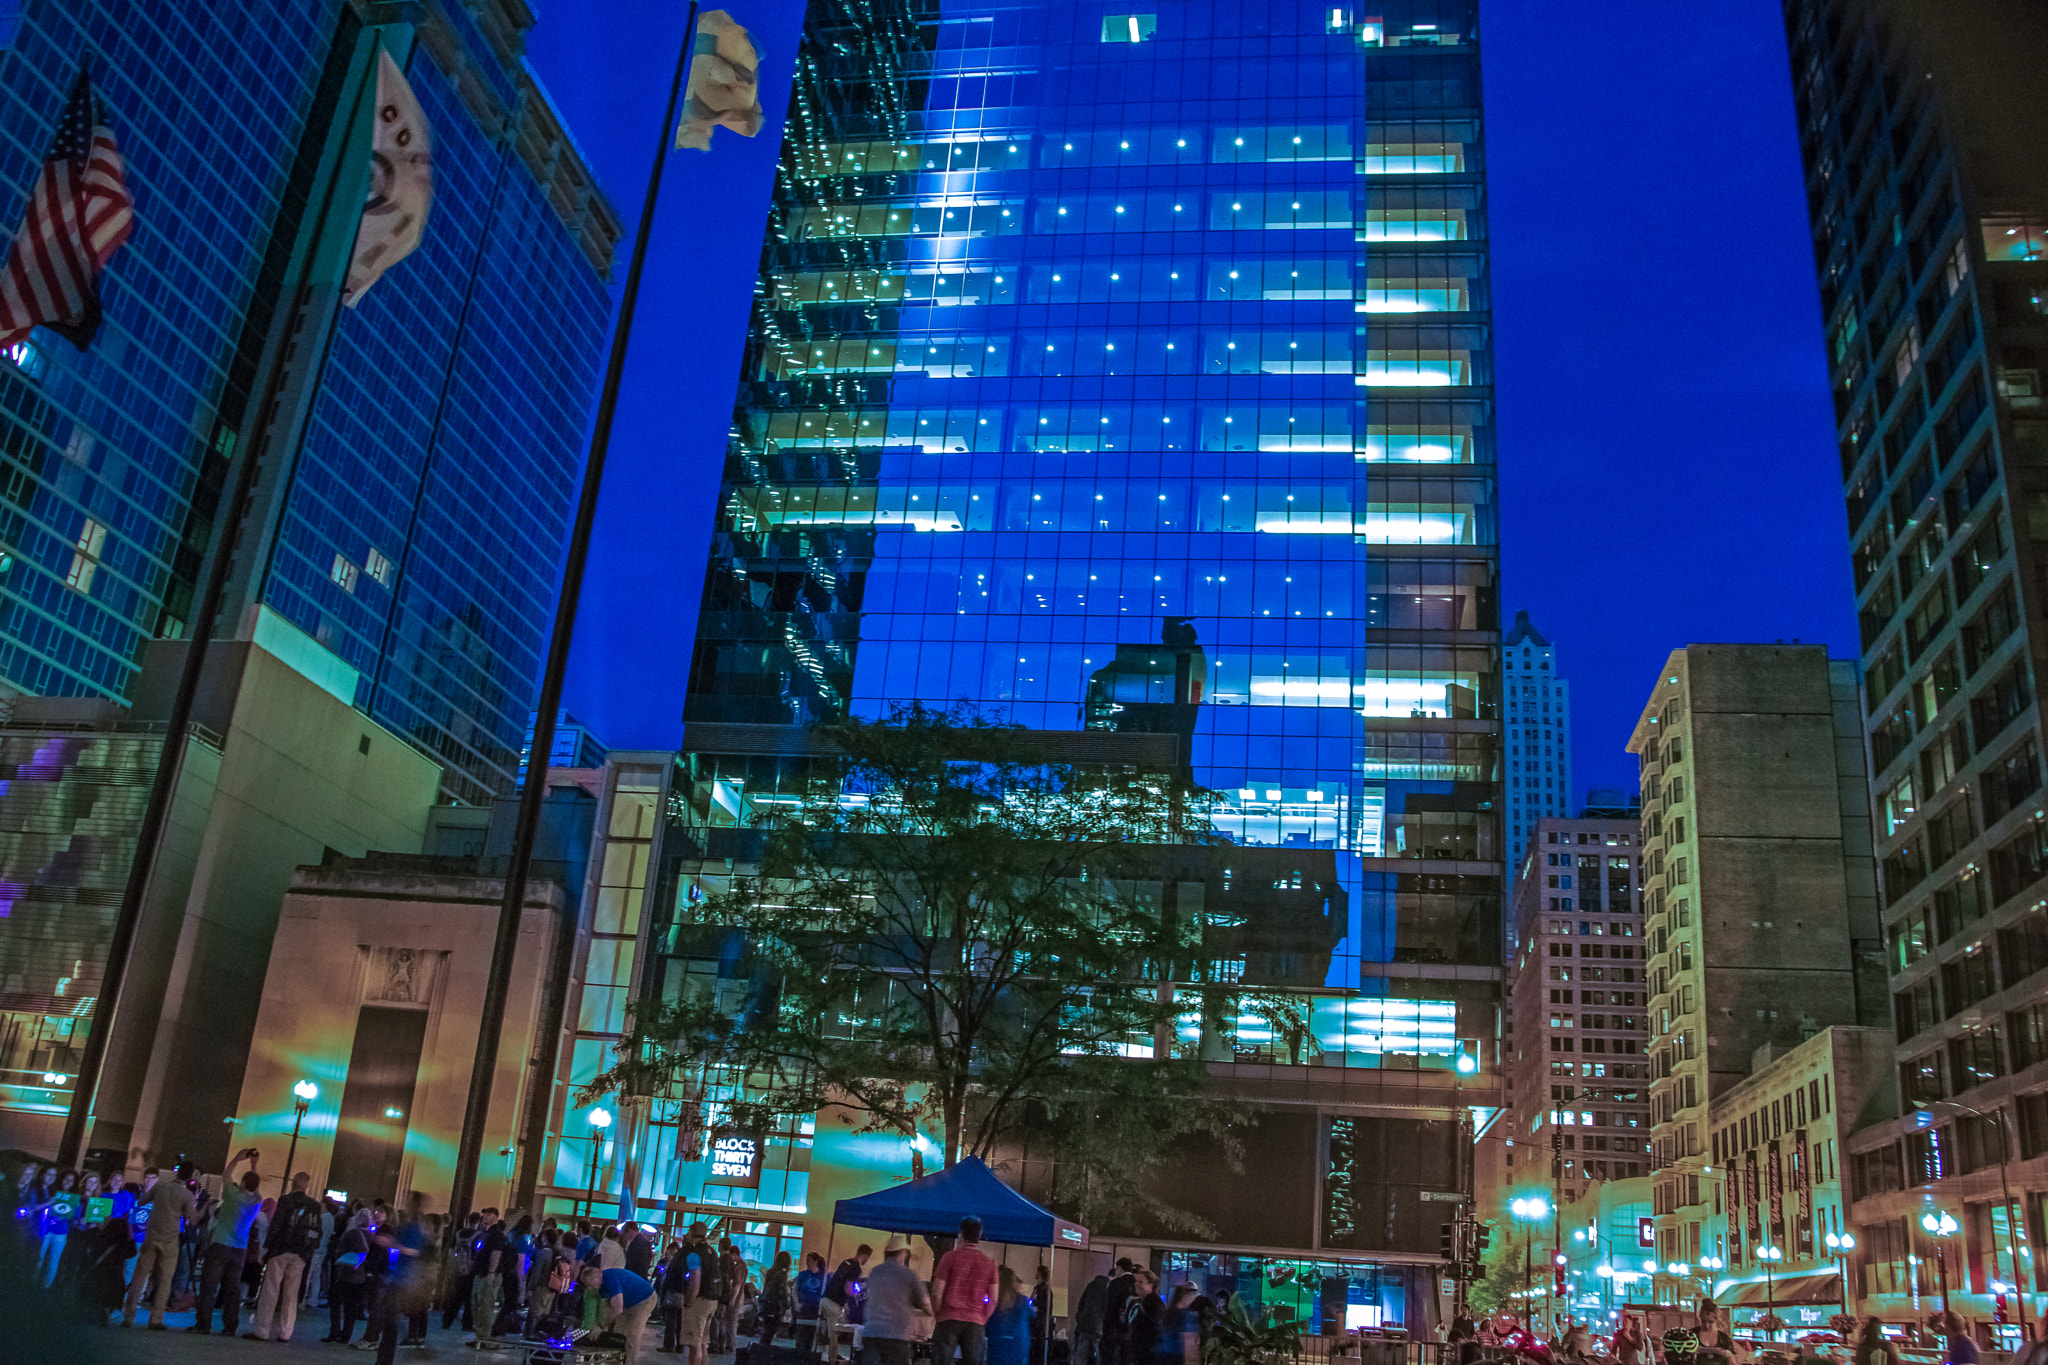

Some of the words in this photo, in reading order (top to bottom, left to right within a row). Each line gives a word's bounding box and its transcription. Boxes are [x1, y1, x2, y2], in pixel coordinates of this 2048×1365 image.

[711, 1163, 751, 1177] SEVEN
[713, 1150, 755, 1165] THIRTY
[715, 1138, 755, 1152] BLOCK
[1728, 1167, 1739, 1236] Walgreens
[1747, 1160, 1759, 1230] Walgreens
[1769, 1149, 1782, 1224] Walgreens
[1796, 1140, 1809, 1220] Walgreens
